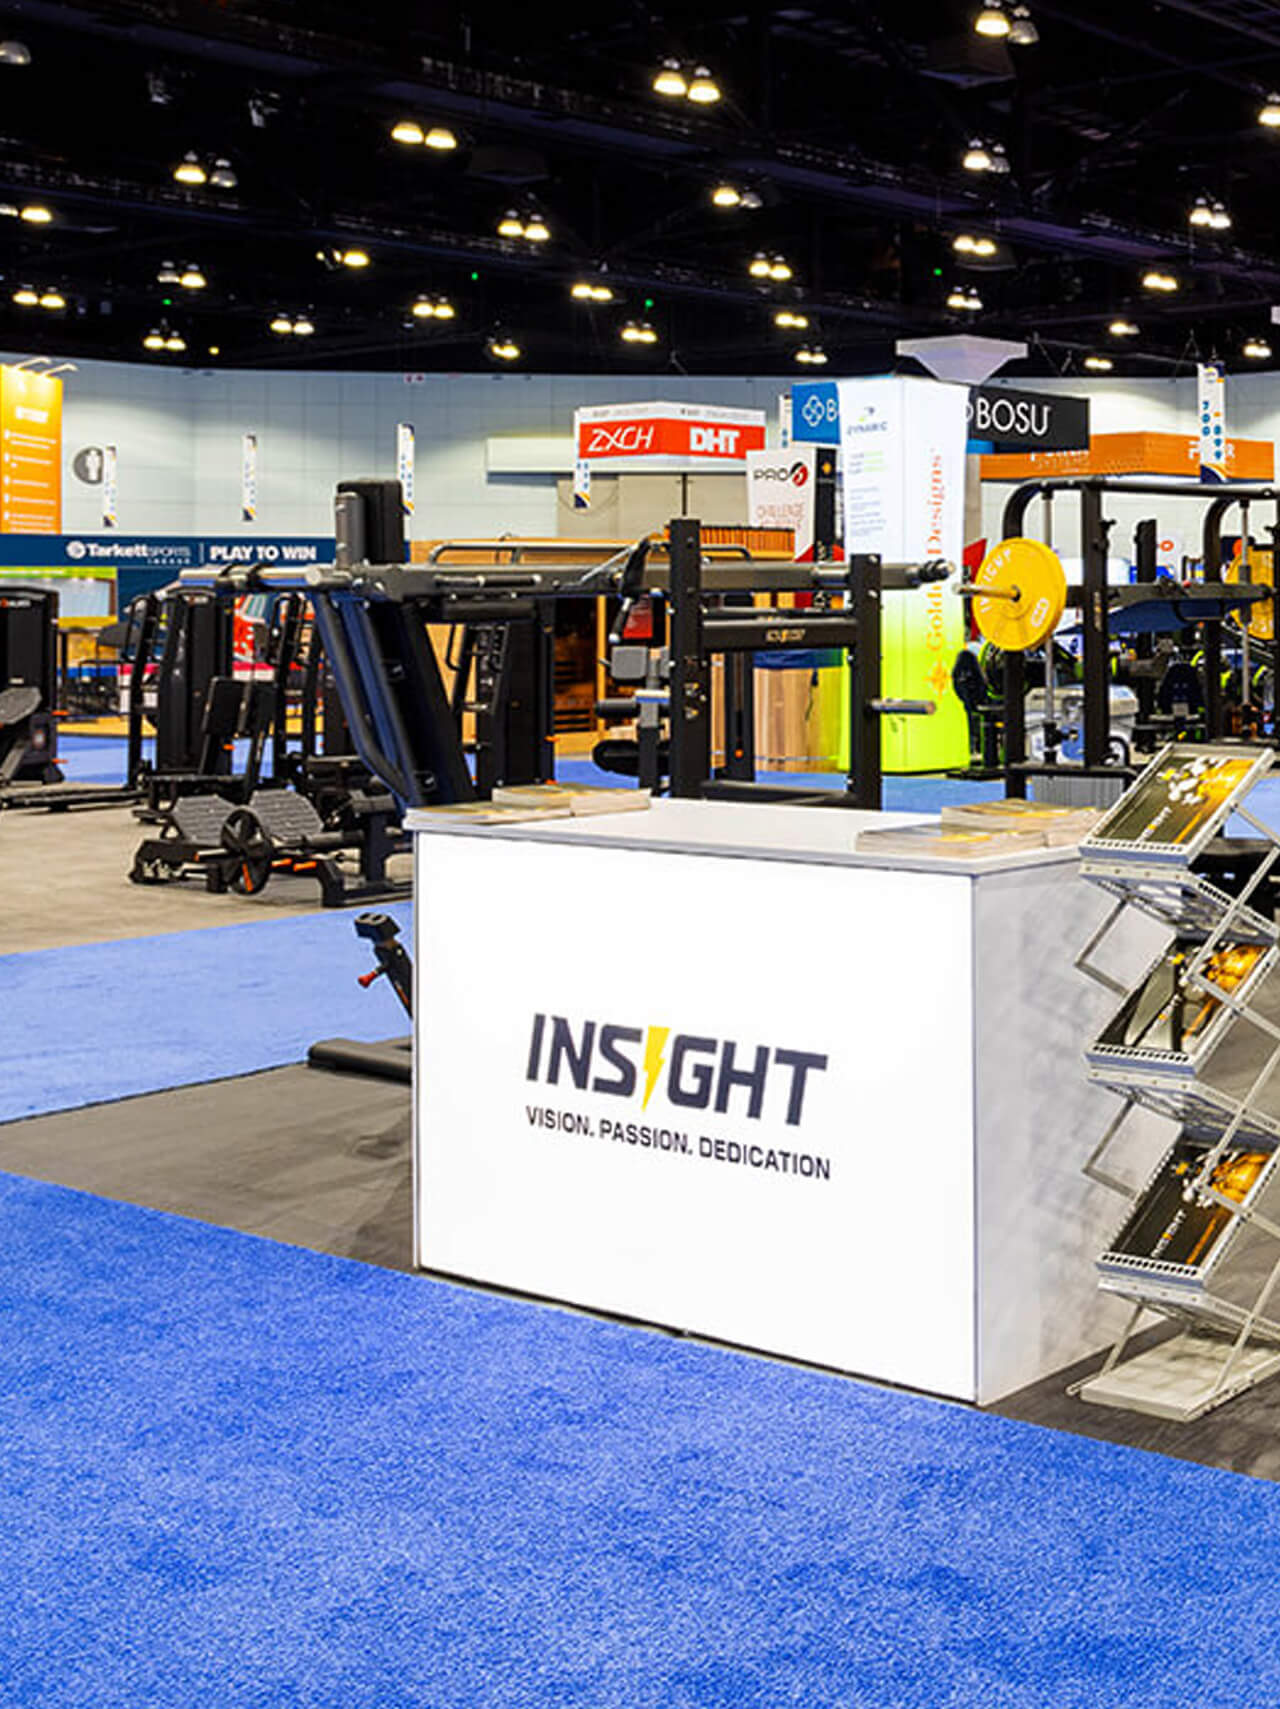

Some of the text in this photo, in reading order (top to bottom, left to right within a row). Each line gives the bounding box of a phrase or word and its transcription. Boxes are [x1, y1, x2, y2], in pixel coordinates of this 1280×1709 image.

[976, 397, 1051, 436] BOSU
[689, 427, 740, 454] DHT
[210, 546, 253, 561] PLAY
[256, 546, 280, 561] TO
[283, 546, 317, 561] WIN
[526, 1013, 829, 1127] INSIGHT
[526, 1105, 831, 1180] VISION. PASSION. DEDICATION
